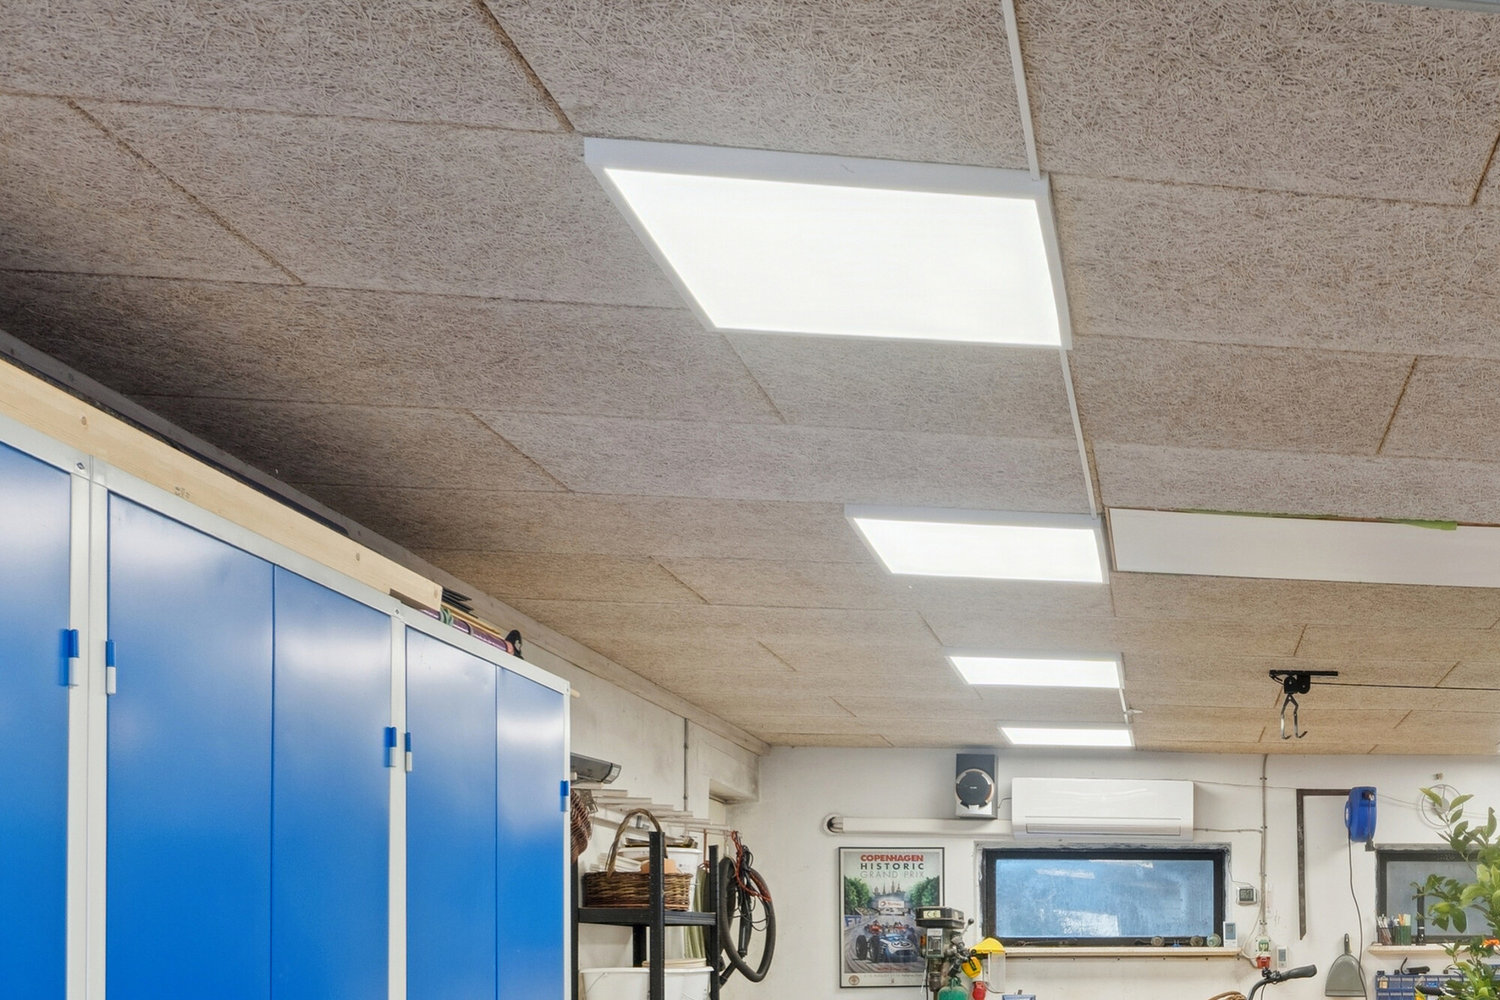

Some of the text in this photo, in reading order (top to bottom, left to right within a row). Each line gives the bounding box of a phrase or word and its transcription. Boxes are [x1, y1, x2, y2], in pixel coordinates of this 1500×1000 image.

[860, 854, 924, 862] COPENHAGEN
[860, 862, 925, 870] HISTORIC
[860, 870, 925, 879] GRAND PRIX
